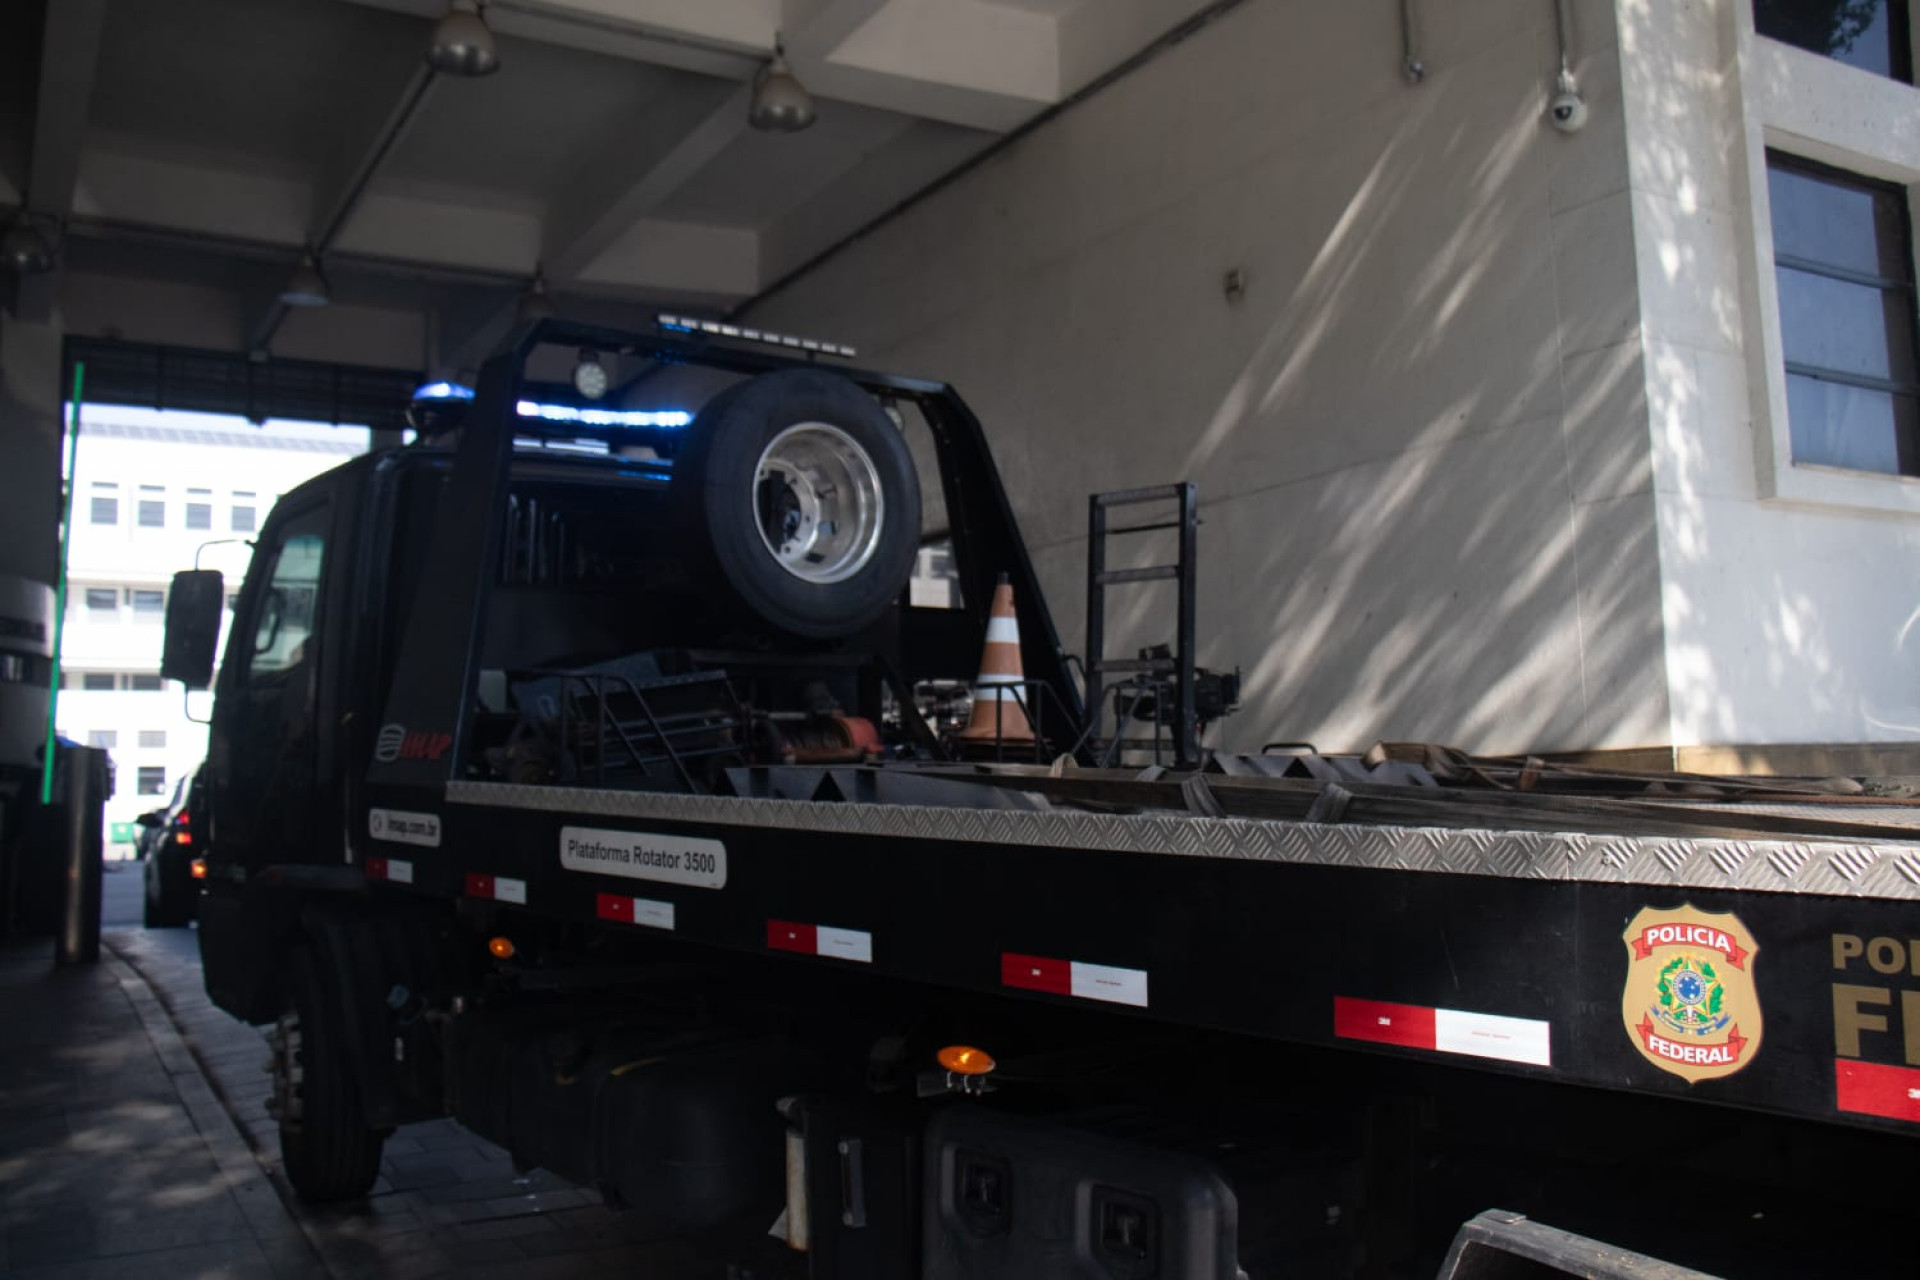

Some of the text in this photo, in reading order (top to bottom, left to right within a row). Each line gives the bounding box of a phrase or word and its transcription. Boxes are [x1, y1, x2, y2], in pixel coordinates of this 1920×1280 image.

[568, 839, 715, 874] Plataforma Rotator 3500
[1649, 1035, 1734, 1064] FEDERAL
